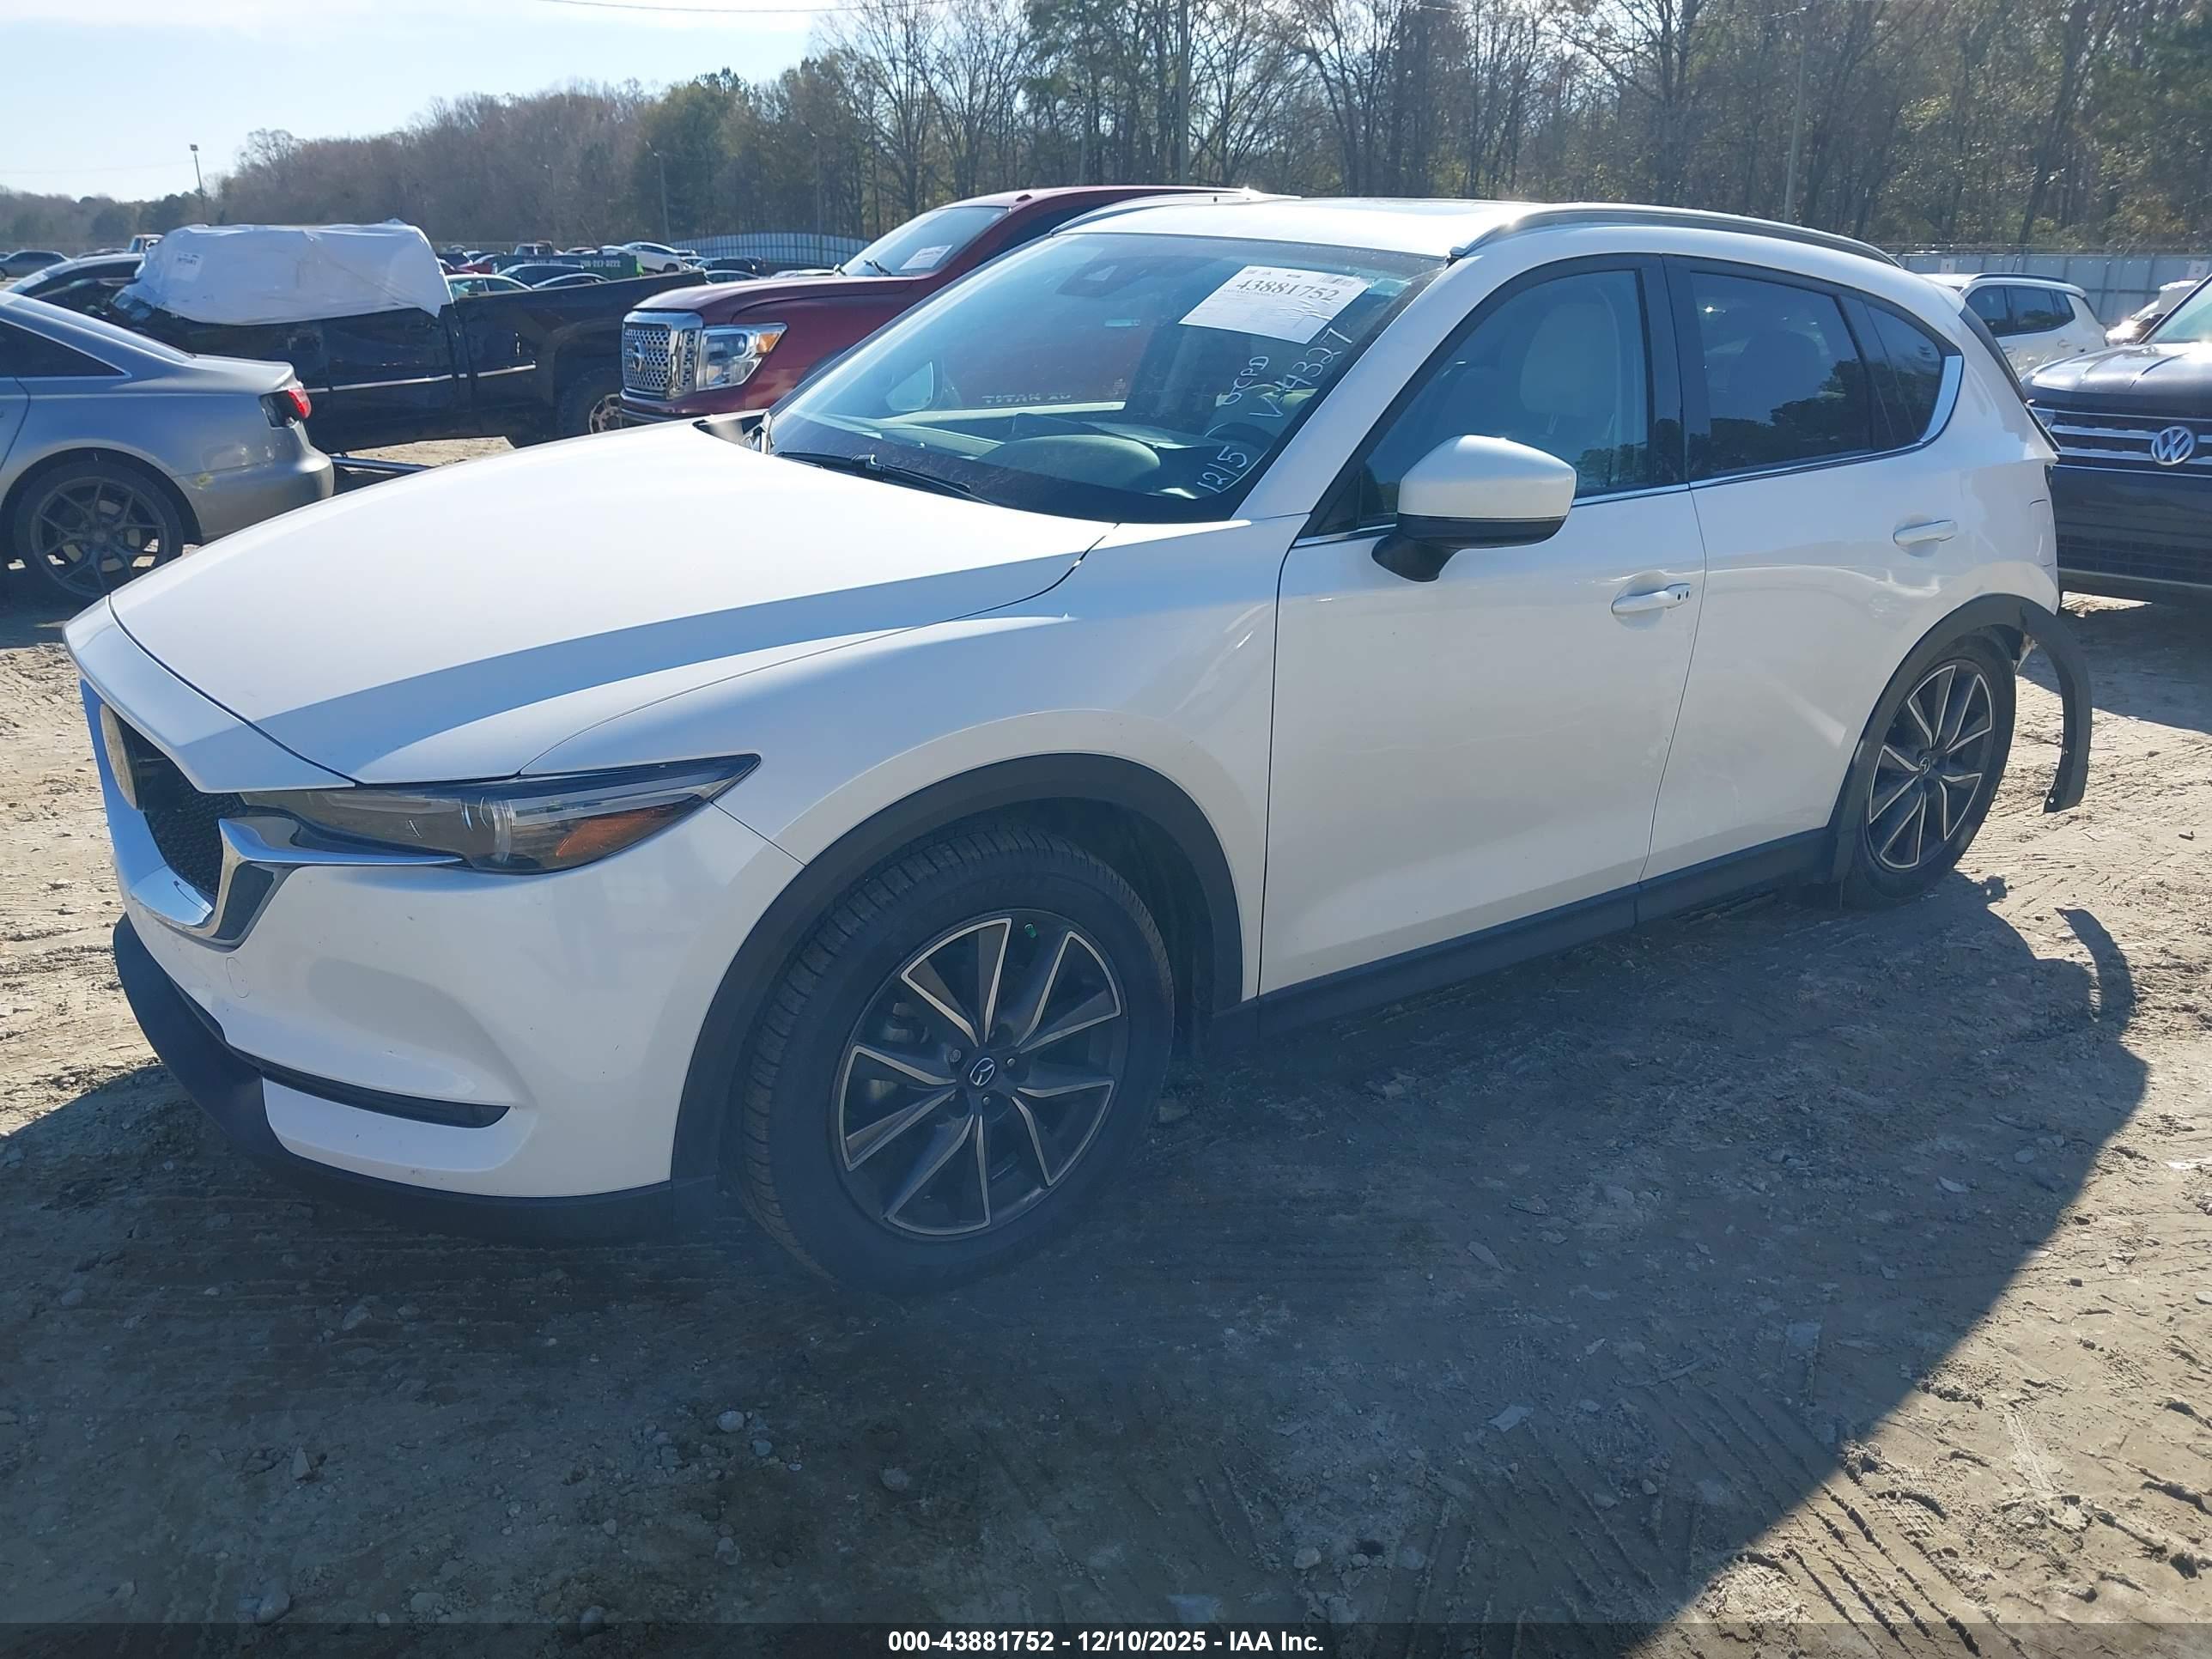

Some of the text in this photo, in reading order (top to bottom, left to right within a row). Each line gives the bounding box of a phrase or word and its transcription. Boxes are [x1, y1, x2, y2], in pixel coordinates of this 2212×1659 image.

[1236, 278, 1340, 301] 43881752
[2154, 427, 2194, 465] VW
[1195, 445, 1248, 494] 12/5
